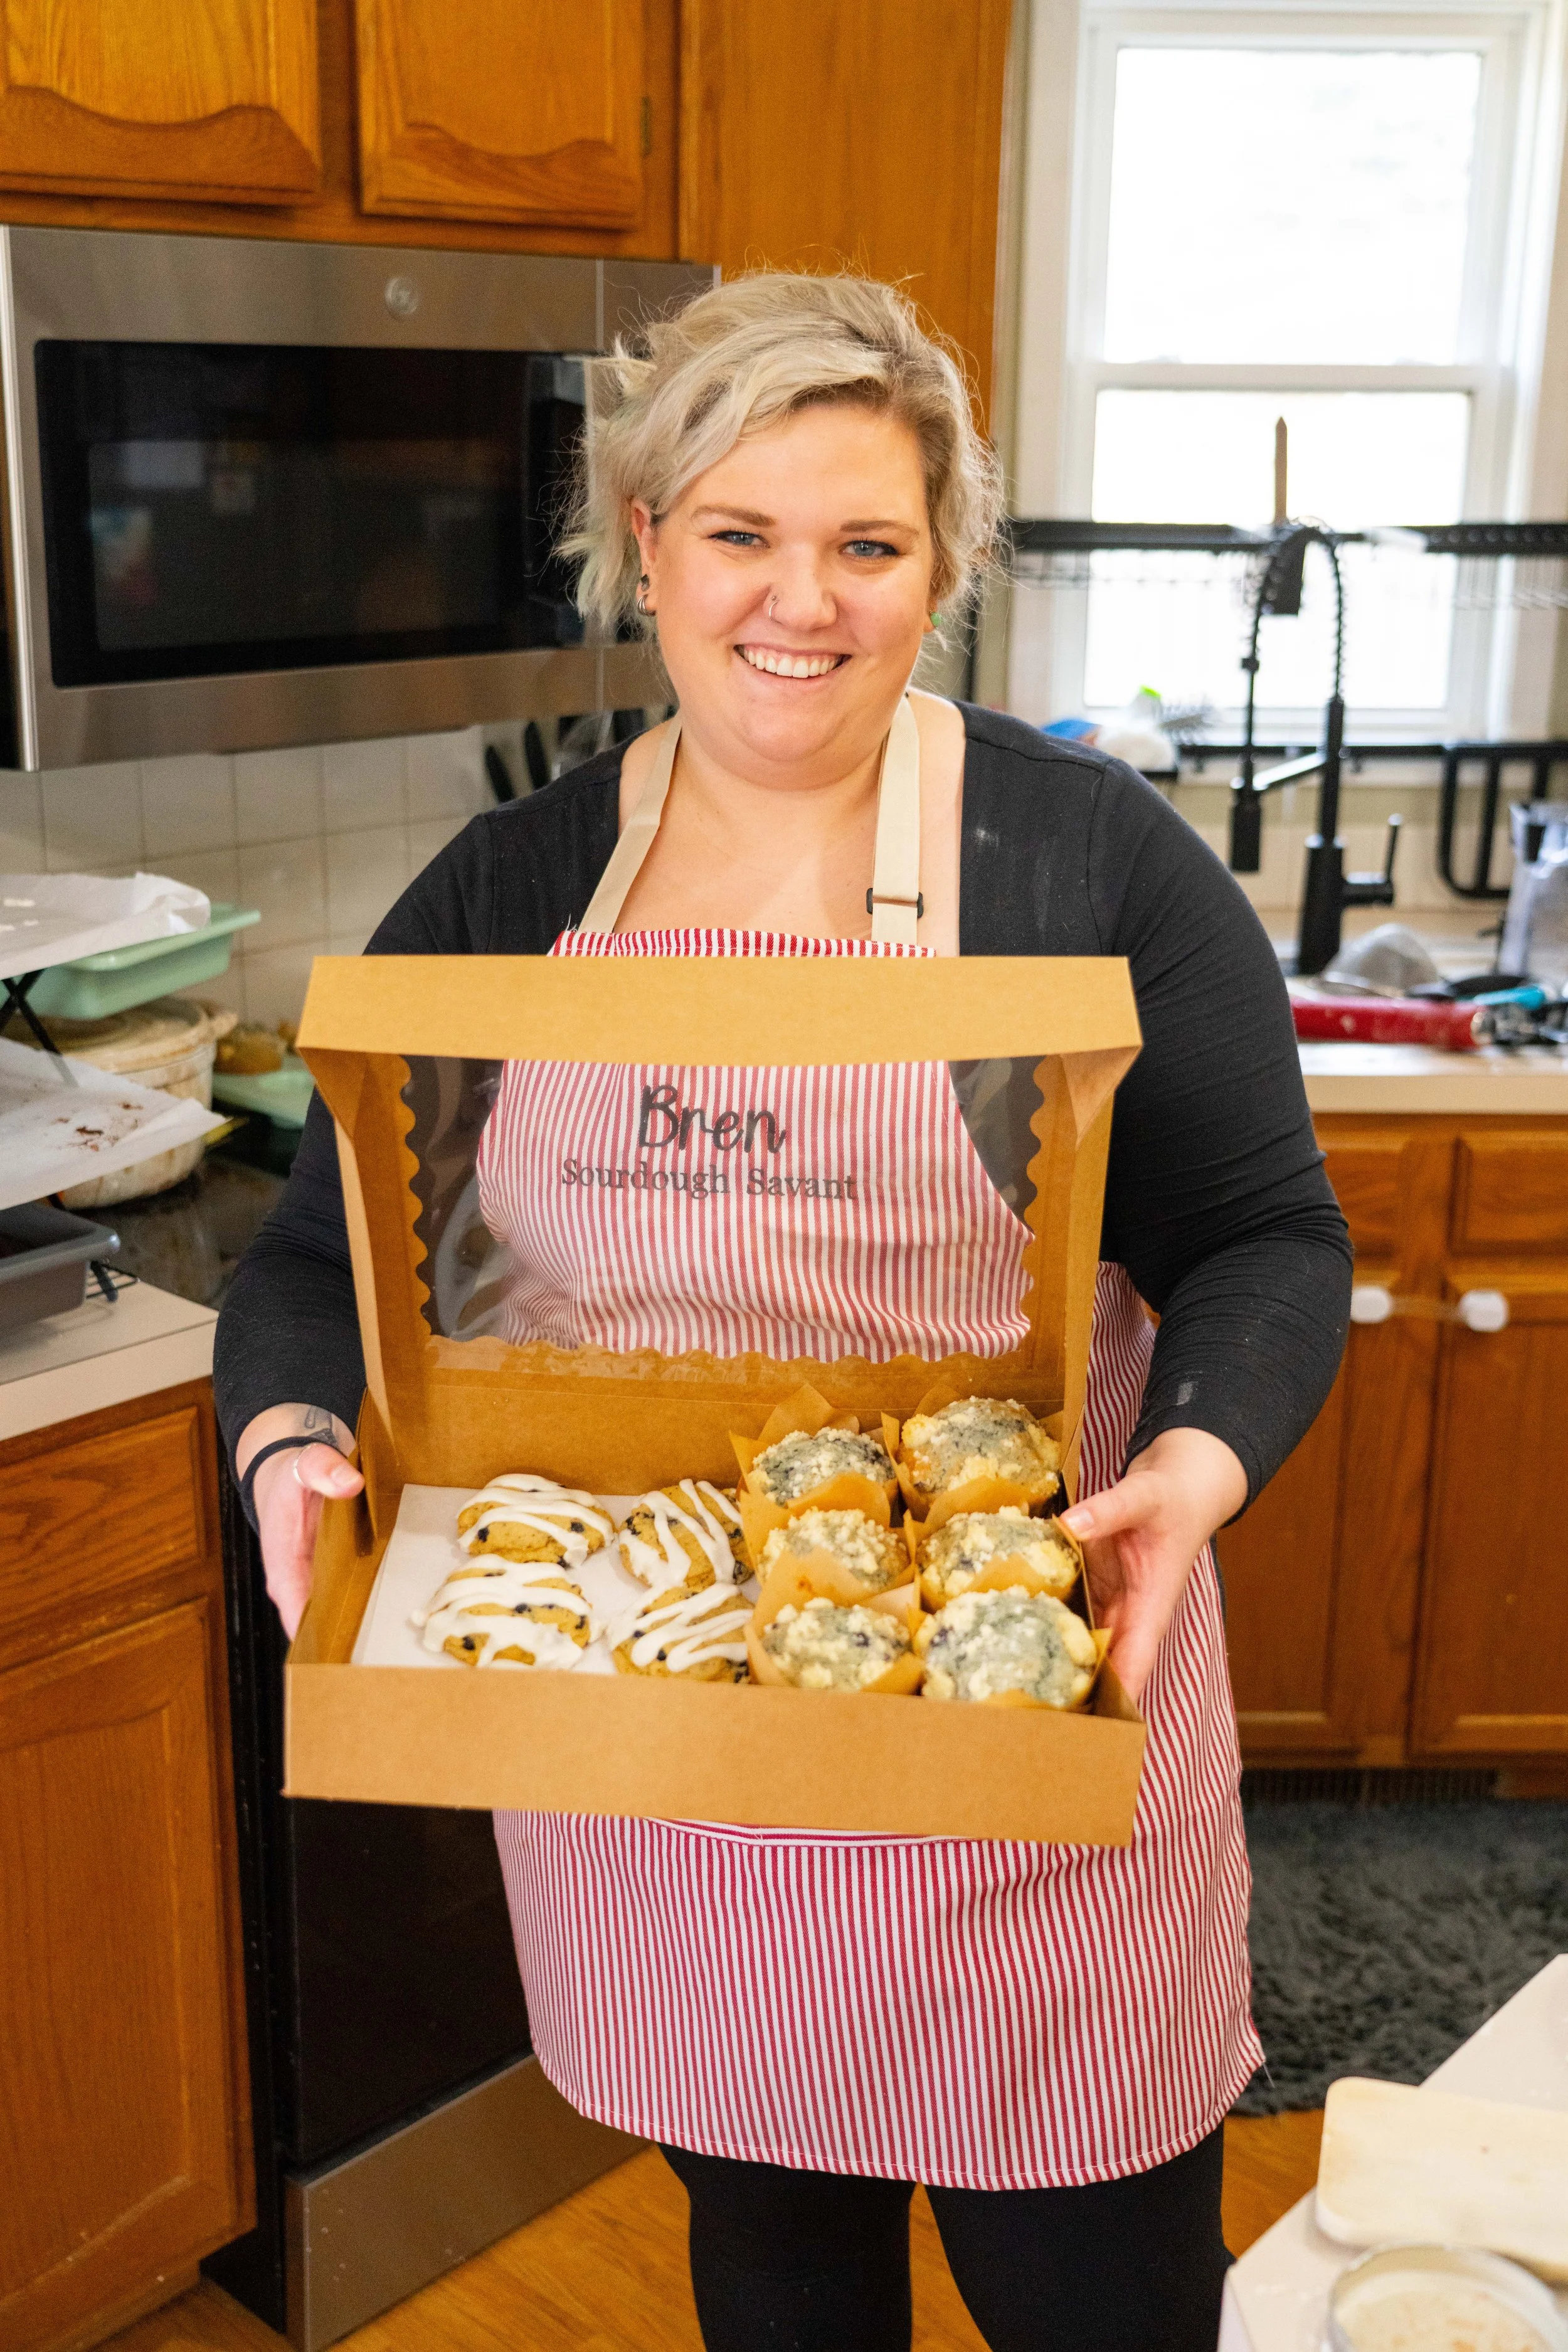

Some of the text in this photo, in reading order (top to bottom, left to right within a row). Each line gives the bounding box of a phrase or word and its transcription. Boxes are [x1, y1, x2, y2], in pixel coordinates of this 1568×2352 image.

[638, 1084, 786, 1153] Bren
[562, 1158, 858, 1200] Sourdough Savant
